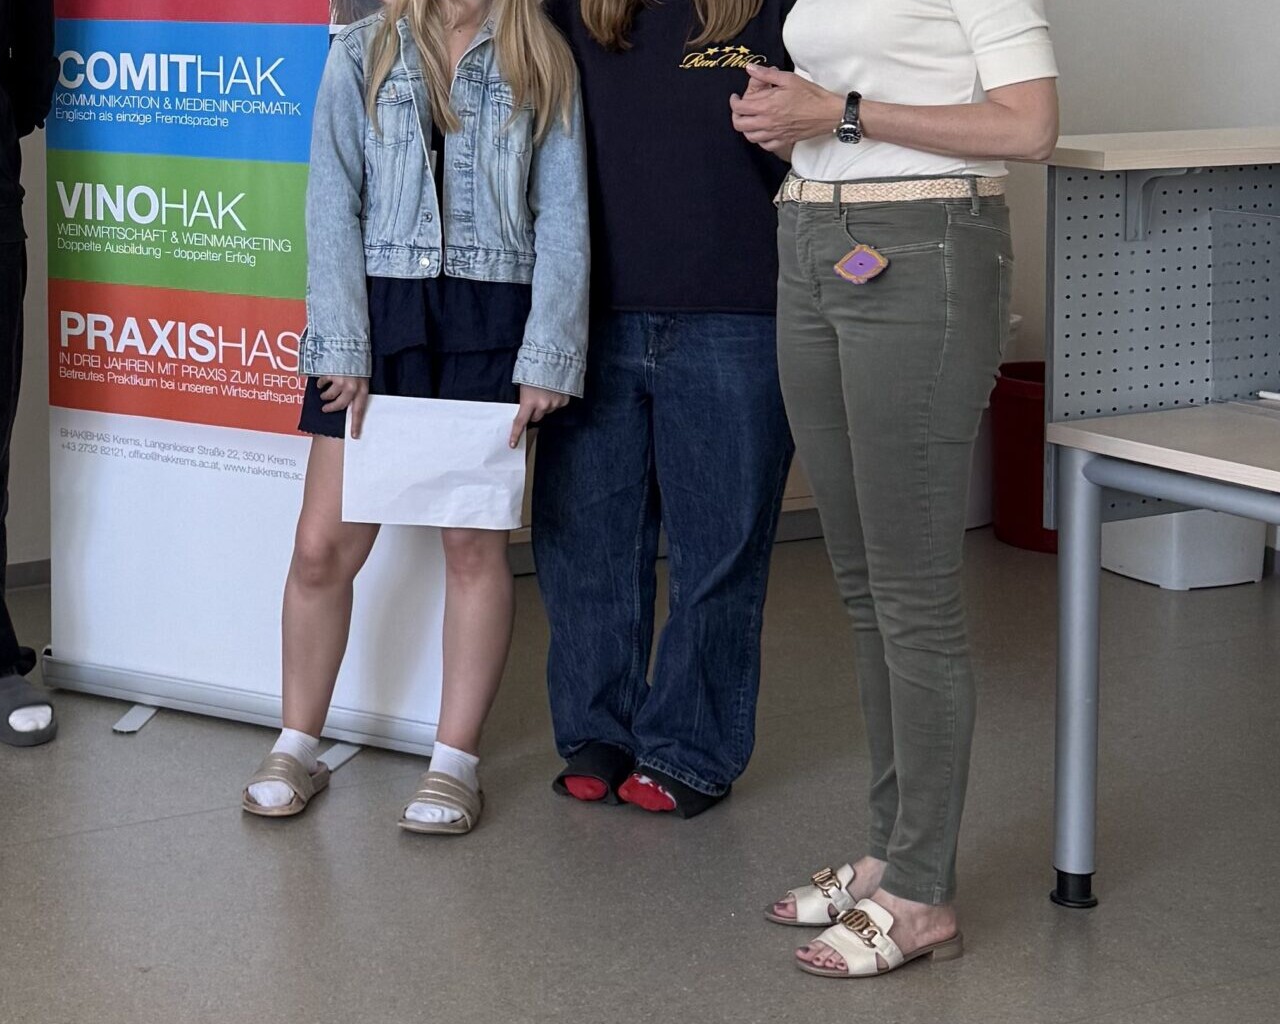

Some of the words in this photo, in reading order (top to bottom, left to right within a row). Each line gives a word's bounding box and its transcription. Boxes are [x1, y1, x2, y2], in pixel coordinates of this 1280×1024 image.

[57, 50, 285, 97] COMITHAK
[55, 92, 160, 110] KOMMUNIKATION
[163, 99, 172, 110] &
[175, 99, 302, 116] MEDIENINFORMATIK
[55, 107, 96, 123] Englisch
[99, 112, 114, 122] als
[116, 112, 152, 125] einzige
[155, 114, 229, 127] Fremdsprache
[56, 181, 247, 231] VINOHAK
[56, 223, 167, 243] WEINWIRTSCHAFT
[170, 231, 180, 243] &
[182, 232, 292, 252] WEINMARKETING
[57, 238, 101, 253] Doppelte
[105, 242, 162, 259] Ausbildung
[174, 247, 221, 261] doppelter
[225, 251, 256, 267] Erfolg
[60, 310, 300, 372] PRAXISHAS
[59, 351, 70, 365] IN
[73, 353, 101, 368] DREI
[104, 356, 154, 374] JAHREN
[158, 361, 177, 377] MIT
[182, 365, 227, 383] PRAXIS
[230, 369, 259, 386] ZUM
[263, 373, 308, 391] ERFOL
[59, 366, 105, 383] Betreutes
[107, 371, 158, 388] Praktikum
[160, 377, 175, 389] bei
[177, 382, 218, 395] unseren
[78, 443, 99, 455] 2732
[243, 451, 265, 463] 3500
[267, 453, 297, 467] Krems
